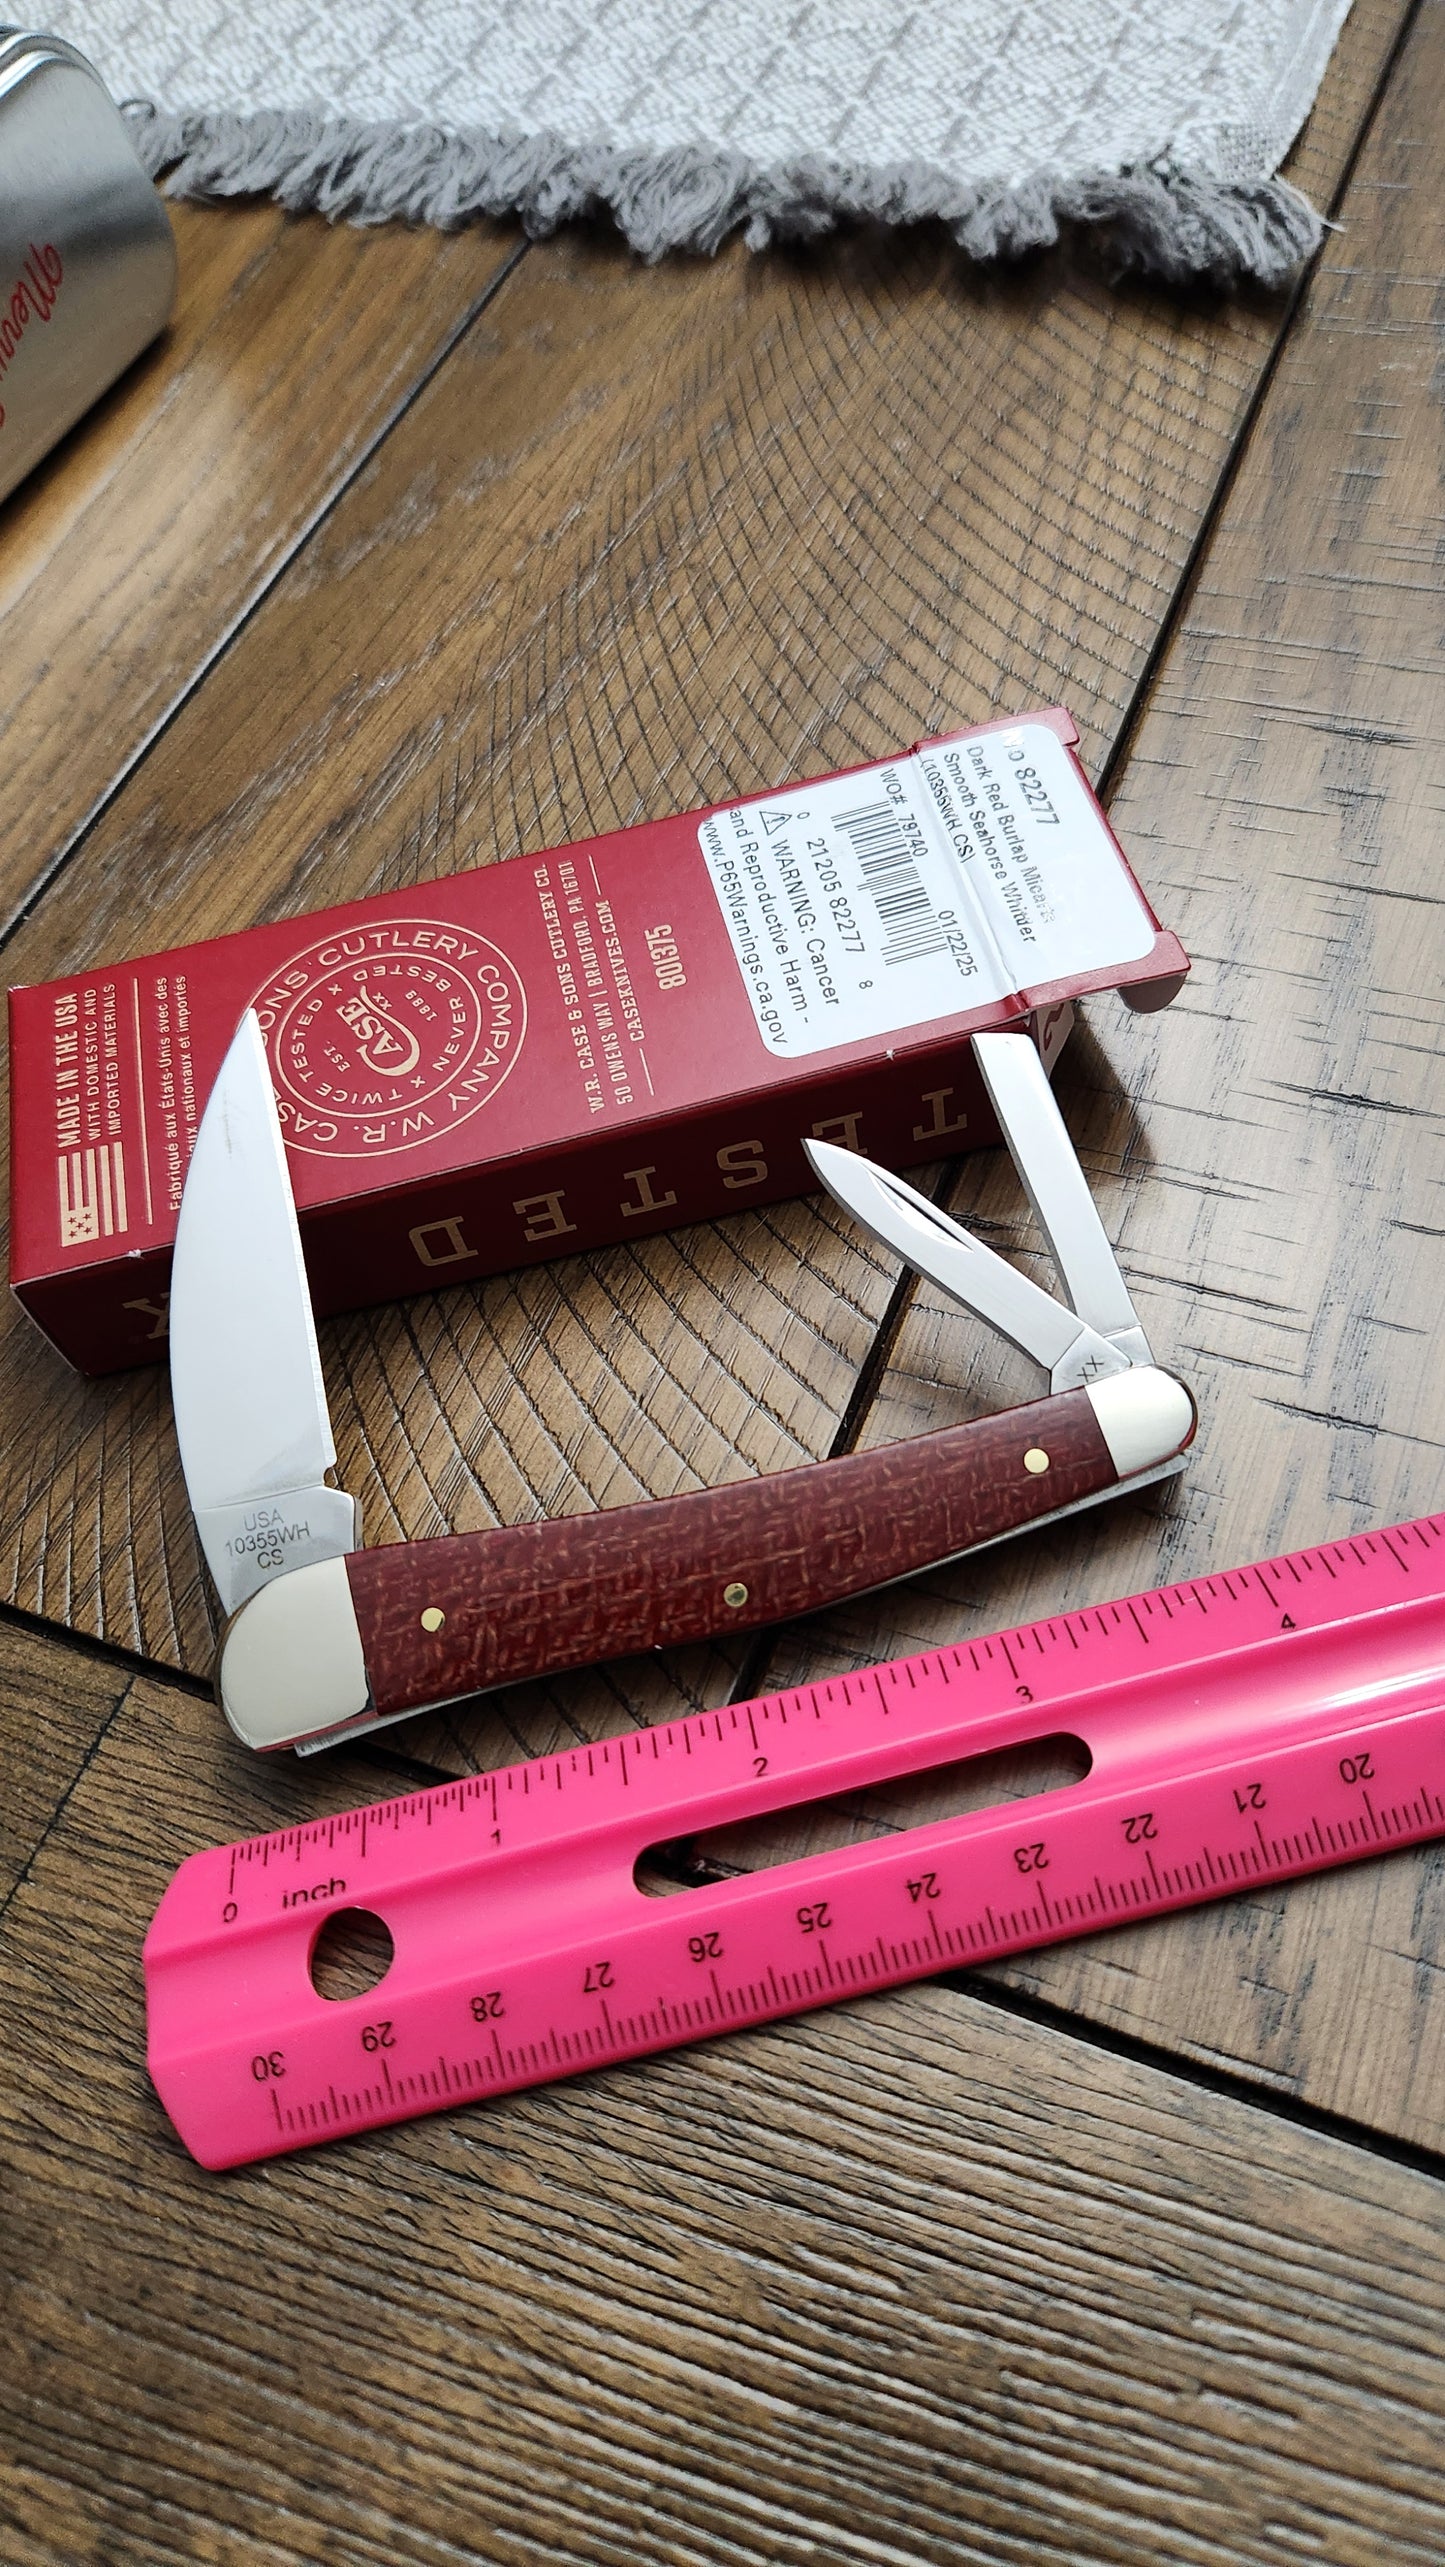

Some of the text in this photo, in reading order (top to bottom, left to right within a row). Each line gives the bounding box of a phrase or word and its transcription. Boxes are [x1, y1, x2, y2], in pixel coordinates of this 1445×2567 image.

[0, 243, 63, 381] Merr
[880, 768, 929, 857] WO# 79740
[966, 745, 993, 781] Dark
[983, 782, 1009, 813] Red
[998, 813, 1029, 865] Burlap
[1014, 766, 1060, 826] 82277
[729, 808, 754, 839] and
[943, 752, 975, 808] Smooth
[969, 809, 1008, 880] Seahorse
[953, 833, 976, 864] CS)
[557, 859, 580, 896] 16701
[567, 895, 585, 914] PA
[740, 841, 790, 956] Reproductive
[806, 837, 843, 893] 21205
[829, 896, 866, 953] 82277
[858, 979, 874, 990] 8
[702, 816, 789, 1045] www.P65Warnings.ca.gov
[771, 838, 841, 1006] WARNING: Cancer
[317, 930, 479, 967] CUTLERY
[572, 914, 603, 988] BRADFORD,
[643, 923, 687, 992] 801375
[938, 909, 978, 977] 01/22/25
[352, 964, 452, 994] BESTED
[595, 898, 645, 1043] CASEKNIVES.COM
[780, 958, 808, 1012] Harm
[176, 975, 191, 1034] importés
[533, 863, 606, 1115] W.R. CASE & SONS CUTLERY CO.
[323, 989, 438, 1073] EST. 1889
[431, 995, 467, 1071] NEVER
[593, 1001, 615, 1031] WAY
[180, 1035, 191, 1049] et
[290, 998, 324, 1084] TESTED
[448, 964, 512, 1111] COMPANY
[54, 992, 82, 1149] MADE IN THE USA
[84, 988, 102, 1141] WITH DOMESTIC AND
[103, 983, 122, 1136] IMPORTED MATERIALS
[600, 1032, 628, 1083] OWENS
[155, 976, 183, 1211] Fabriqué aux États-Unis avec des
[180, 1052, 198, 1121] nationaux
[315, 1082, 403, 1105] TWICE
[613, 1085, 634, 1106] 50
[352, 1111, 435, 1143] W.R.
[407, 1087, 969, 1268] TESTED
[1076, 1354, 1104, 1382] XX
[244, 1508, 284, 1531] USA
[225, 1521, 311, 1557] 10355WH
[257, 1549, 284, 1569] CS
[1279, 1611, 1297, 1632] 4
[1016, 1684, 1035, 1705] 3
[753, 1756, 770, 1778] 2
[1339, 1752, 1376, 1785] 20
[1232, 1783, 1267, 1814] 21
[490, 1829, 502, 1845] 1
[1121, 1812, 1159, 1844] 22
[1012, 1842, 1052, 1874] 23
[280, 1878, 347, 1910] inch
[905, 1872, 942, 1904] 24
[222, 1902, 238, 1924] 0
[796, 1901, 833, 1934] 25
[688, 1931, 724, 1963] 26
[582, 1961, 615, 1993] 27
[471, 1992, 506, 2023] 28
[361, 2021, 394, 2052] 29
[251, 2051, 288, 2082] 30
